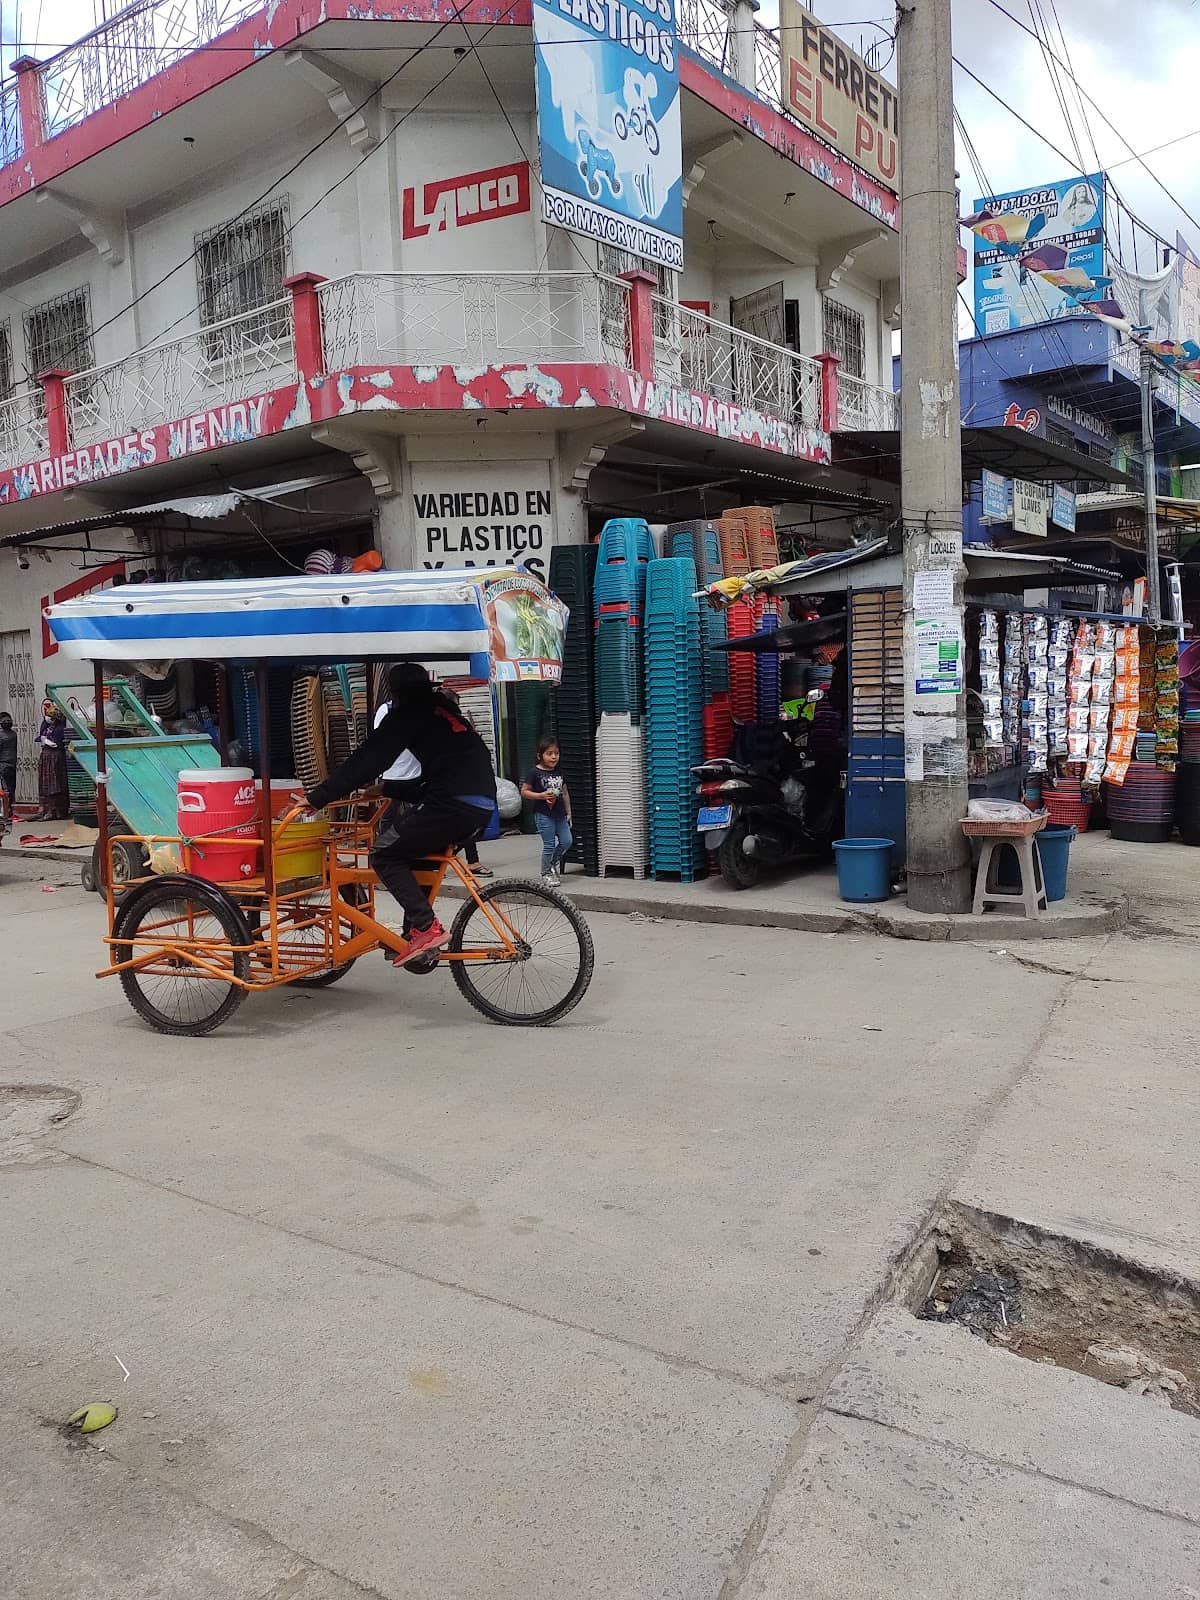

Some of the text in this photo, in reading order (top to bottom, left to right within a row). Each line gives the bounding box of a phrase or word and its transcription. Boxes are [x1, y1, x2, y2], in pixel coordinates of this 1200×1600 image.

[549, 0, 674, 72] ASTICOS
[789, 56, 837, 139] EL
[403, 174, 520, 240] LANCO
[984, 189, 1057, 214] SURTIDORA
[577, 205, 627, 247] MAYOR
[627, 223, 638, 250] Y
[639, 229, 683, 267] MENOR
[1071, 252, 1095, 263] pepsi
[13, 397, 266, 500] VARIEDADES WENDY
[1015, 480, 1023, 495] SE
[413, 490, 551, 518] VARIEDAD EN
[1021, 496, 1041, 514] LLAVES
[426, 524, 543, 552] PLASTICO
[930, 542, 956, 555] LOCALES
[234, 786, 255, 800] ACE
